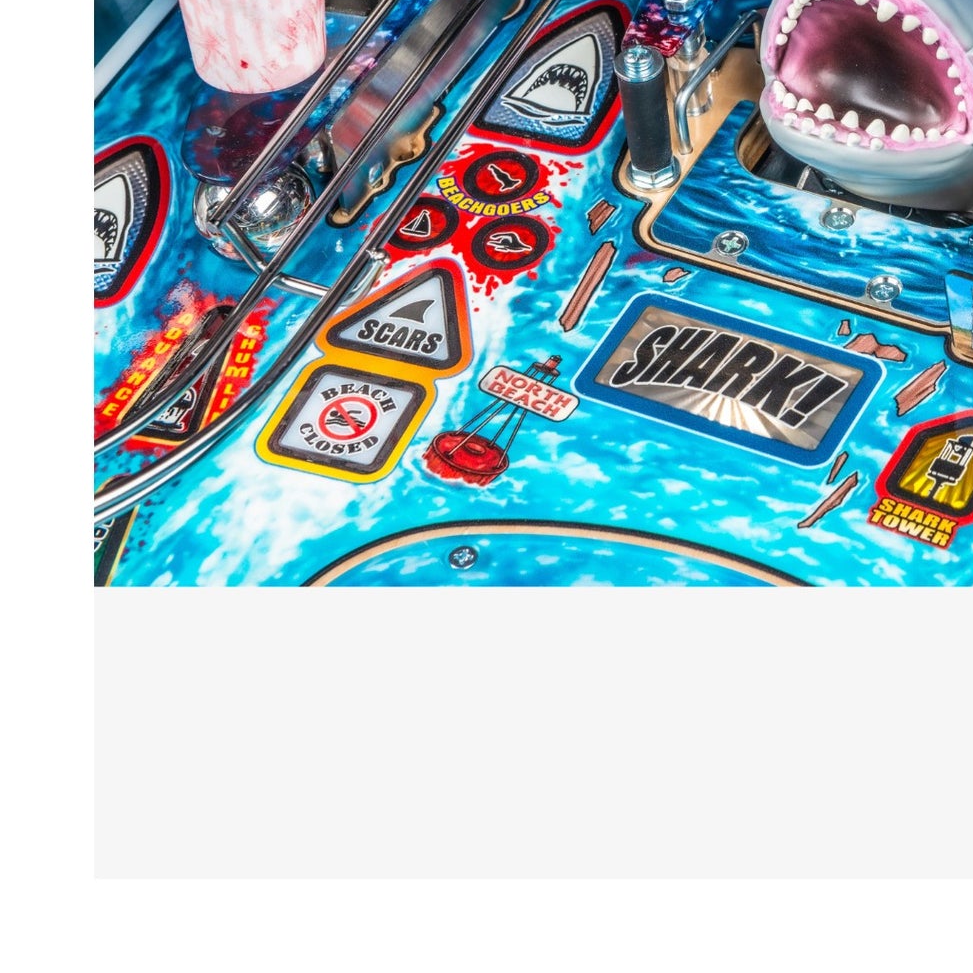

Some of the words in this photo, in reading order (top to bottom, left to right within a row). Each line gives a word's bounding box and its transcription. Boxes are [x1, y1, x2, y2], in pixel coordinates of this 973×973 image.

[437, 176, 551, 216] BEACHGOERS
[214, 324, 263, 378] CHUM
[357, 318, 443, 355] SCARS
[493, 368, 574, 408] NORTH
[608, 325, 849, 430] SHARK!
[320, 382, 398, 413] BEACH
[487, 382, 562, 418] BEACH
[299, 422, 380, 455] CLOSED
[870, 508, 950, 547] TOWER
[878, 497, 957, 535] SHARK
